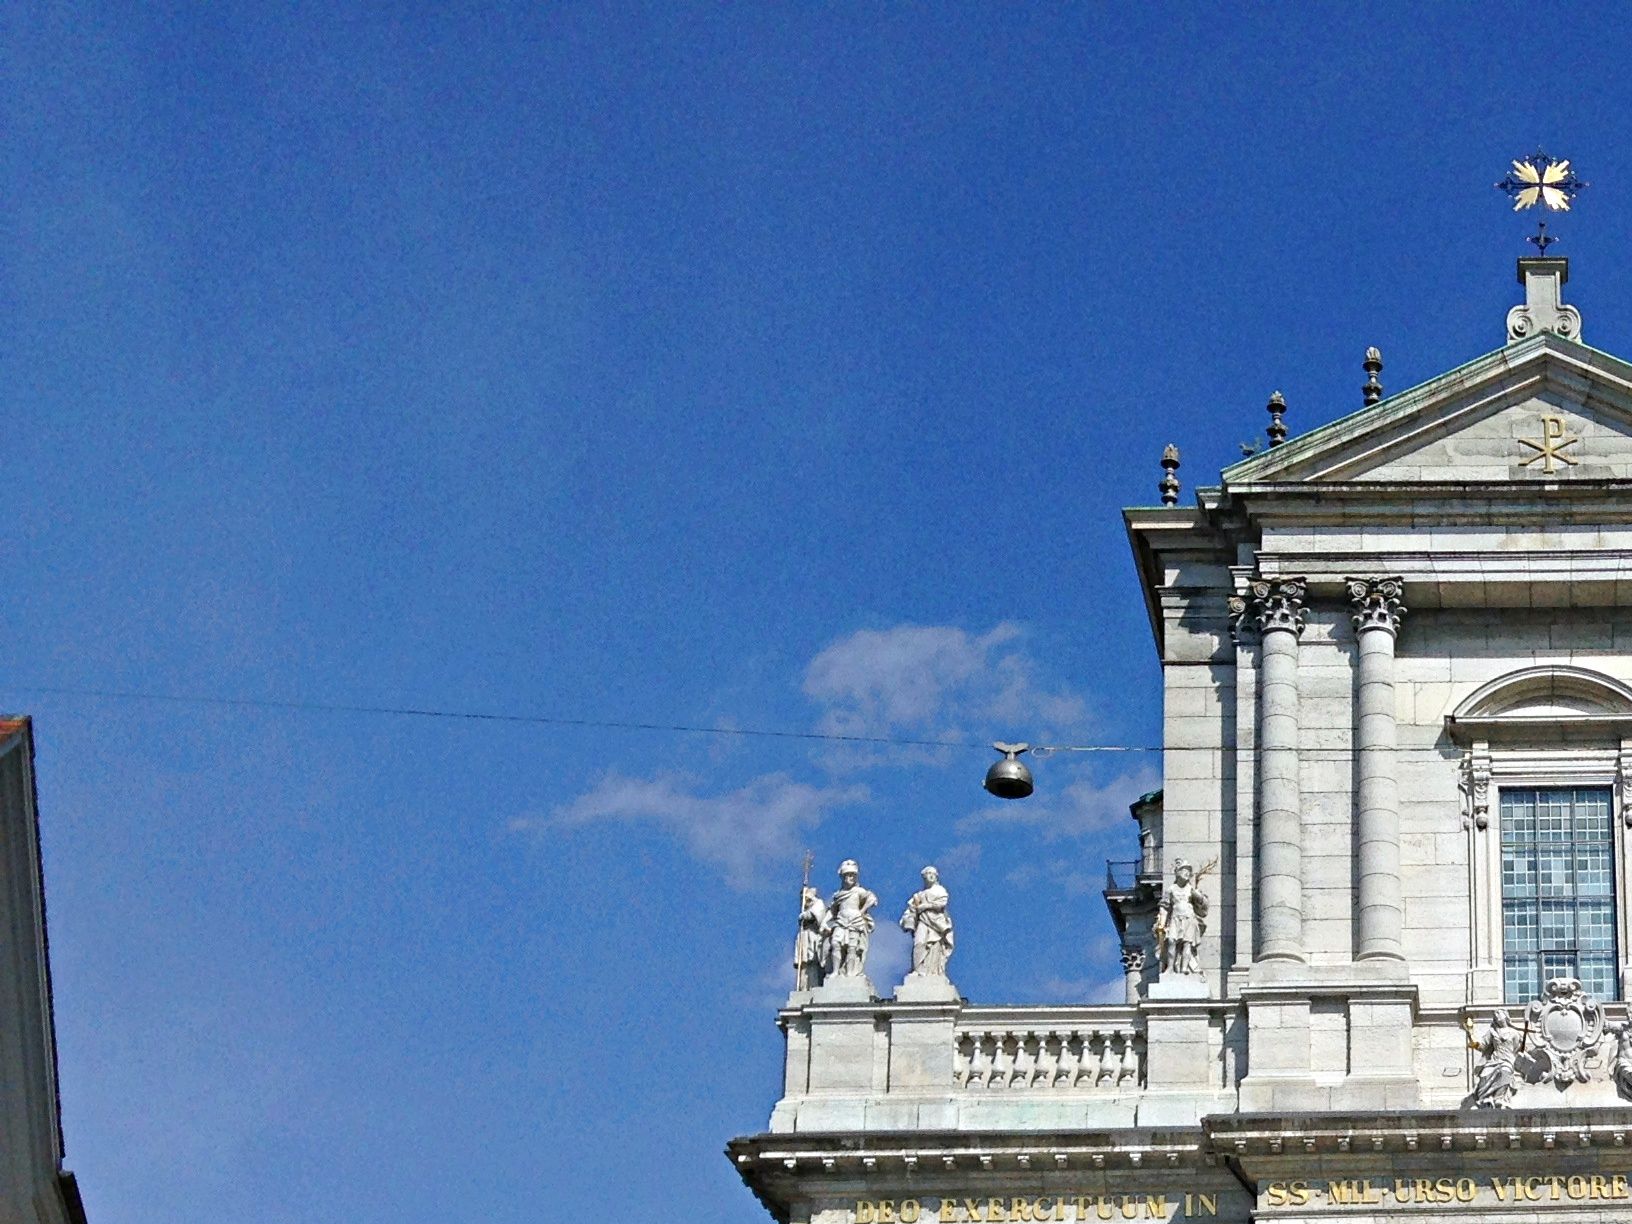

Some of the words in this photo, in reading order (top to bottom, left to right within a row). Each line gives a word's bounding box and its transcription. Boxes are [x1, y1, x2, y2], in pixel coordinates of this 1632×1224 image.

[1394, 1176, 1477, 1203] URSO
[1490, 1174, 1629, 1201] VICTORE
[854, 1198, 921, 1224] DEO
[939, 1194, 1168, 1224] EXERCITUUM
[1184, 1193, 1218, 1218] IN
